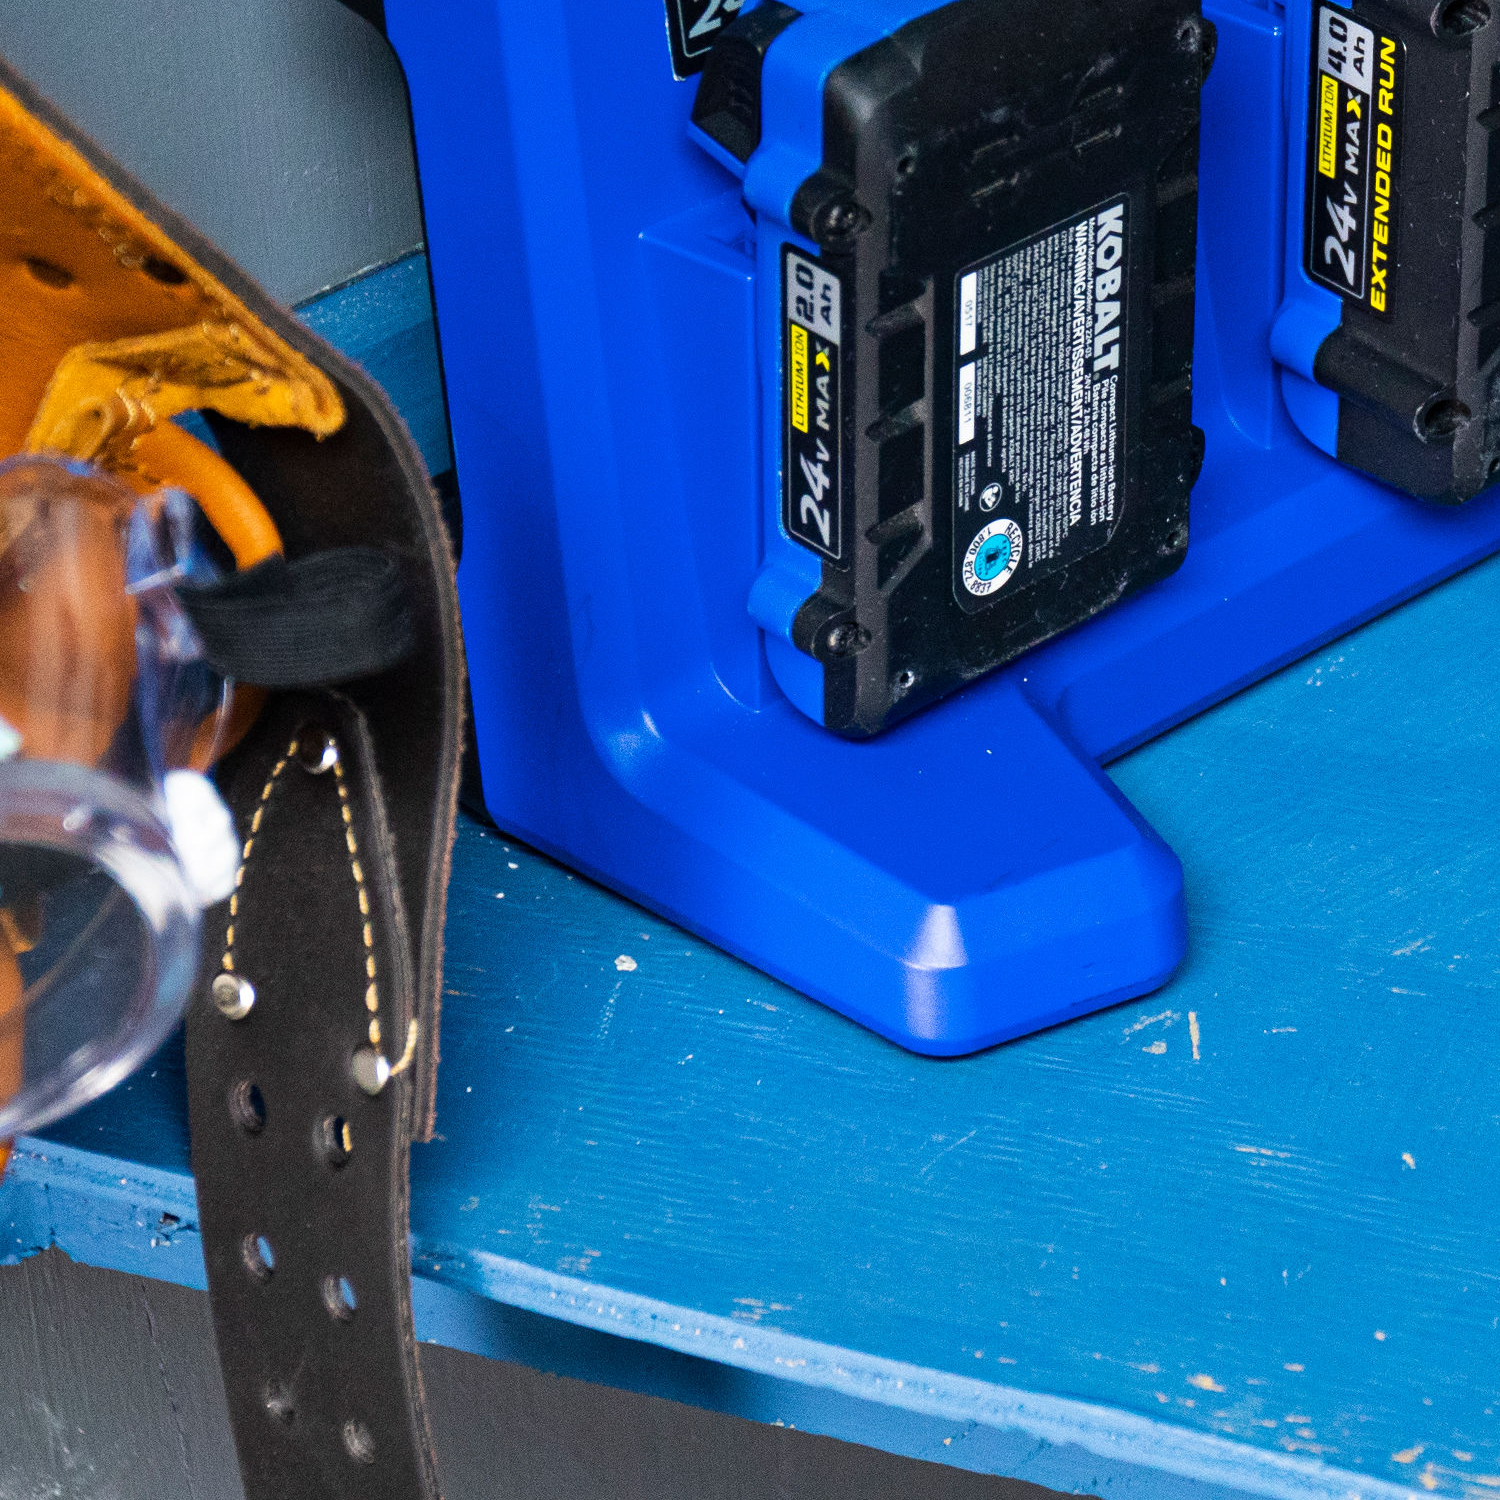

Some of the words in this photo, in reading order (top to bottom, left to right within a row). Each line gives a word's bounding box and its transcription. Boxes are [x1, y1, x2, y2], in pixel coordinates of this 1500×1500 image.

[1325, 14, 1349, 76] 4.0
[1351, 33, 1366, 77] Ah
[1322, 78, 1335, 107] ION
[1375, 35, 1397, 115] RUN
[1319, 107, 1335, 173] LITHIUM
[1341, 88, 1363, 175] MAX
[1366, 121, 1396, 313] EXTENDED
[795, 259, 814, 324] 2.0
[819, 279, 832, 326] Ah
[964, 298, 972, 328] 0517
[1092, 202, 1123, 377] KOBALT
[793, 329, 804, 357] ION
[1086, 314, 1092, 328] KB
[794, 359, 805, 428] LITHIUM
[815, 340, 830, 431] MAX
[1068, 220, 1088, 527] WARNING/AVERTISSEMENT/ADVERTENCIA
[1108, 373, 1117, 422] Compact
[963, 380, 971, 424] 006811
[1084, 406, 1090, 414] 2
[1084, 413, 1089, 426] Ah
[1099, 398, 1108, 452] compacte
[1083, 438, 1089, 455] Wh
[1091, 420, 1099, 472] compacta
[1099, 451, 1106, 466] au
[1107, 422, 1116, 482] Lithium-ion
[1090, 472, 1097, 487] de
[1097, 465, 1106, 523] lithium-ion
[1106, 482, 1114, 522] Battery
[1004, 523, 1020, 575] RECYCLE
